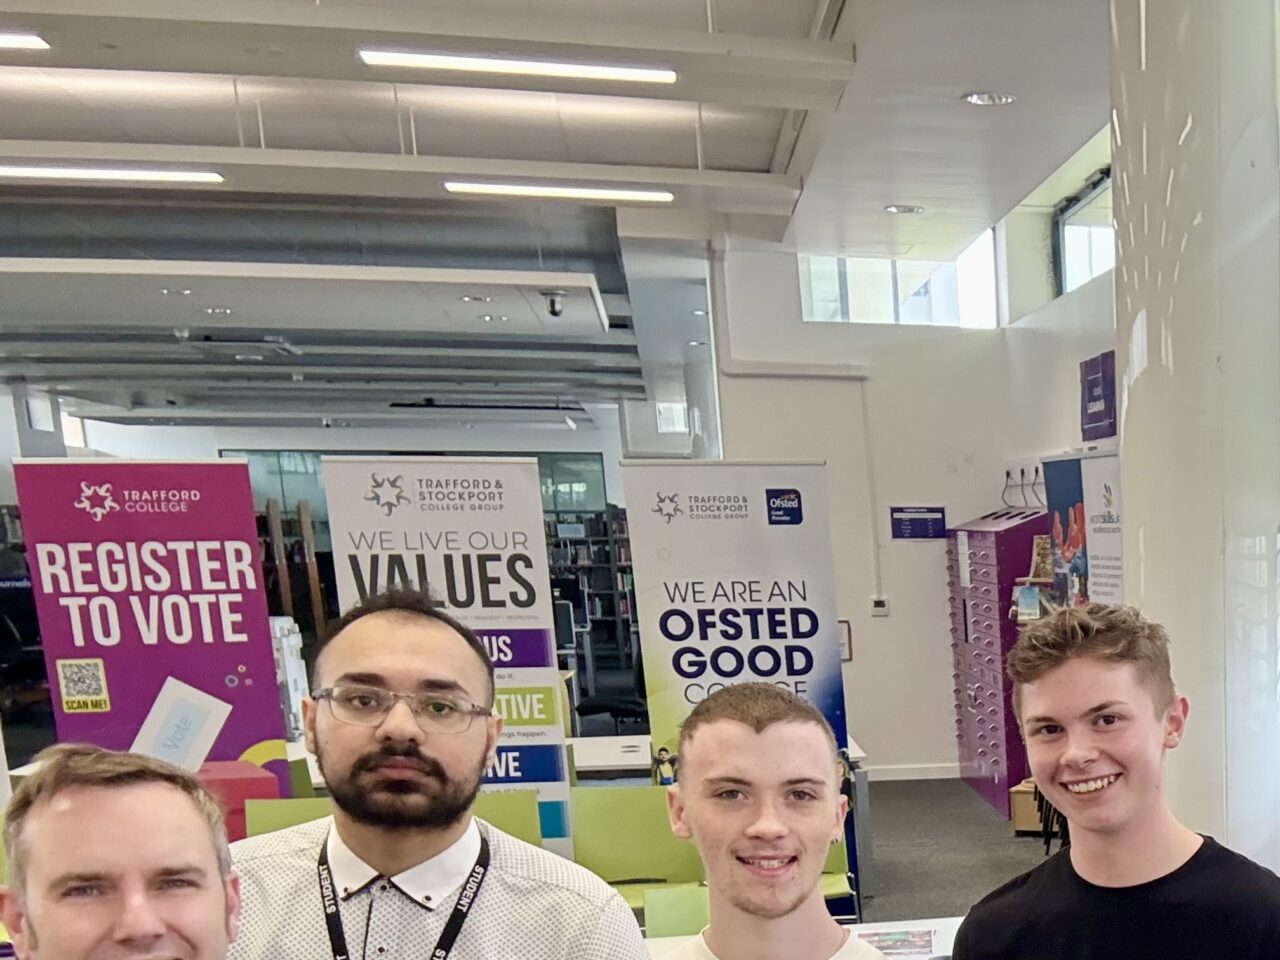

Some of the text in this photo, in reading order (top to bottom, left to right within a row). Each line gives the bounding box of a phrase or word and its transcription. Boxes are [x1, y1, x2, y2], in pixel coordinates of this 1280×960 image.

[417, 479, 503, 489] TRAFFORD &
[122, 490, 200, 501] TRAFFORD
[418, 491, 503, 501] STOCKPORT
[770, 498, 798, 508] Ofsted
[124, 502, 188, 513] COLLEGE
[420, 503, 504, 511] COLLEGE GROUP
[688, 504, 748, 513] STOCKPORT
[349, 530, 528, 551] WE LIVE OUR
[36, 540, 257, 594] REGISTER
[348, 552, 536, 609] VALUES
[663, 580, 807, 603] WE ARE AN
[59, 593, 248, 647] TO VOTE
[659, 607, 819, 642] OFSTED
[672, 645, 814, 679] GOOD
[65, 699, 107, 711] SCAN ME!
[163, 715, 193, 749] Vote
[319, 864, 337, 914] STUDENT
[457, 864, 484, 913] STUDENT
